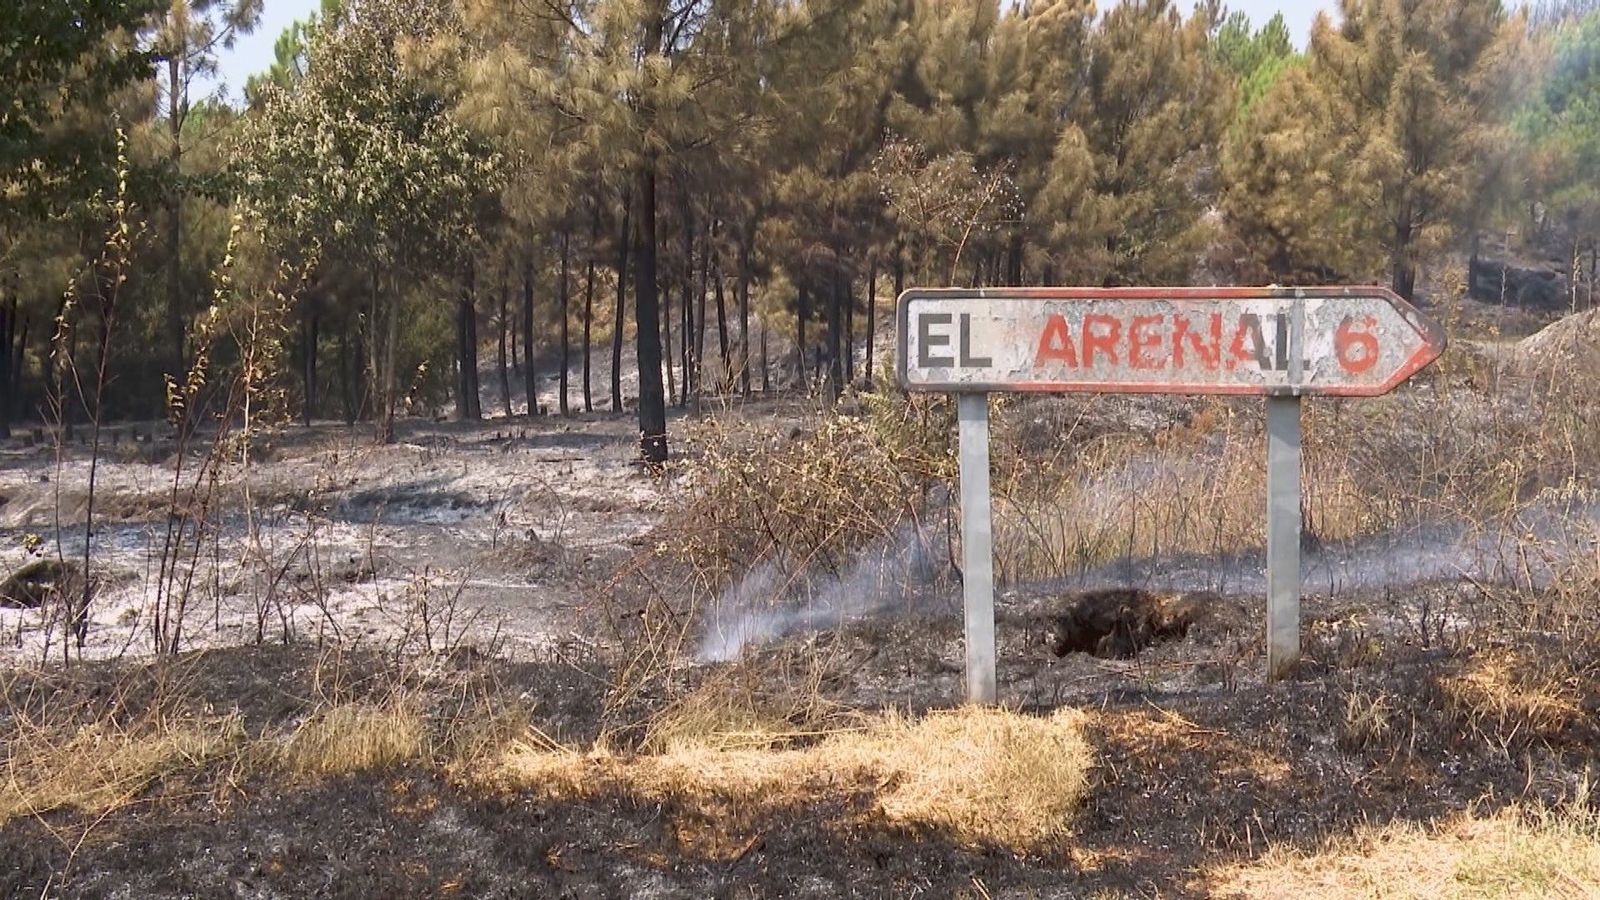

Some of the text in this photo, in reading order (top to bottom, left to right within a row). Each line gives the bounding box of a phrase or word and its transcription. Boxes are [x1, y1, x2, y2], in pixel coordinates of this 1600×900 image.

[917, 312, 1380, 374] EL ARENAL 6
